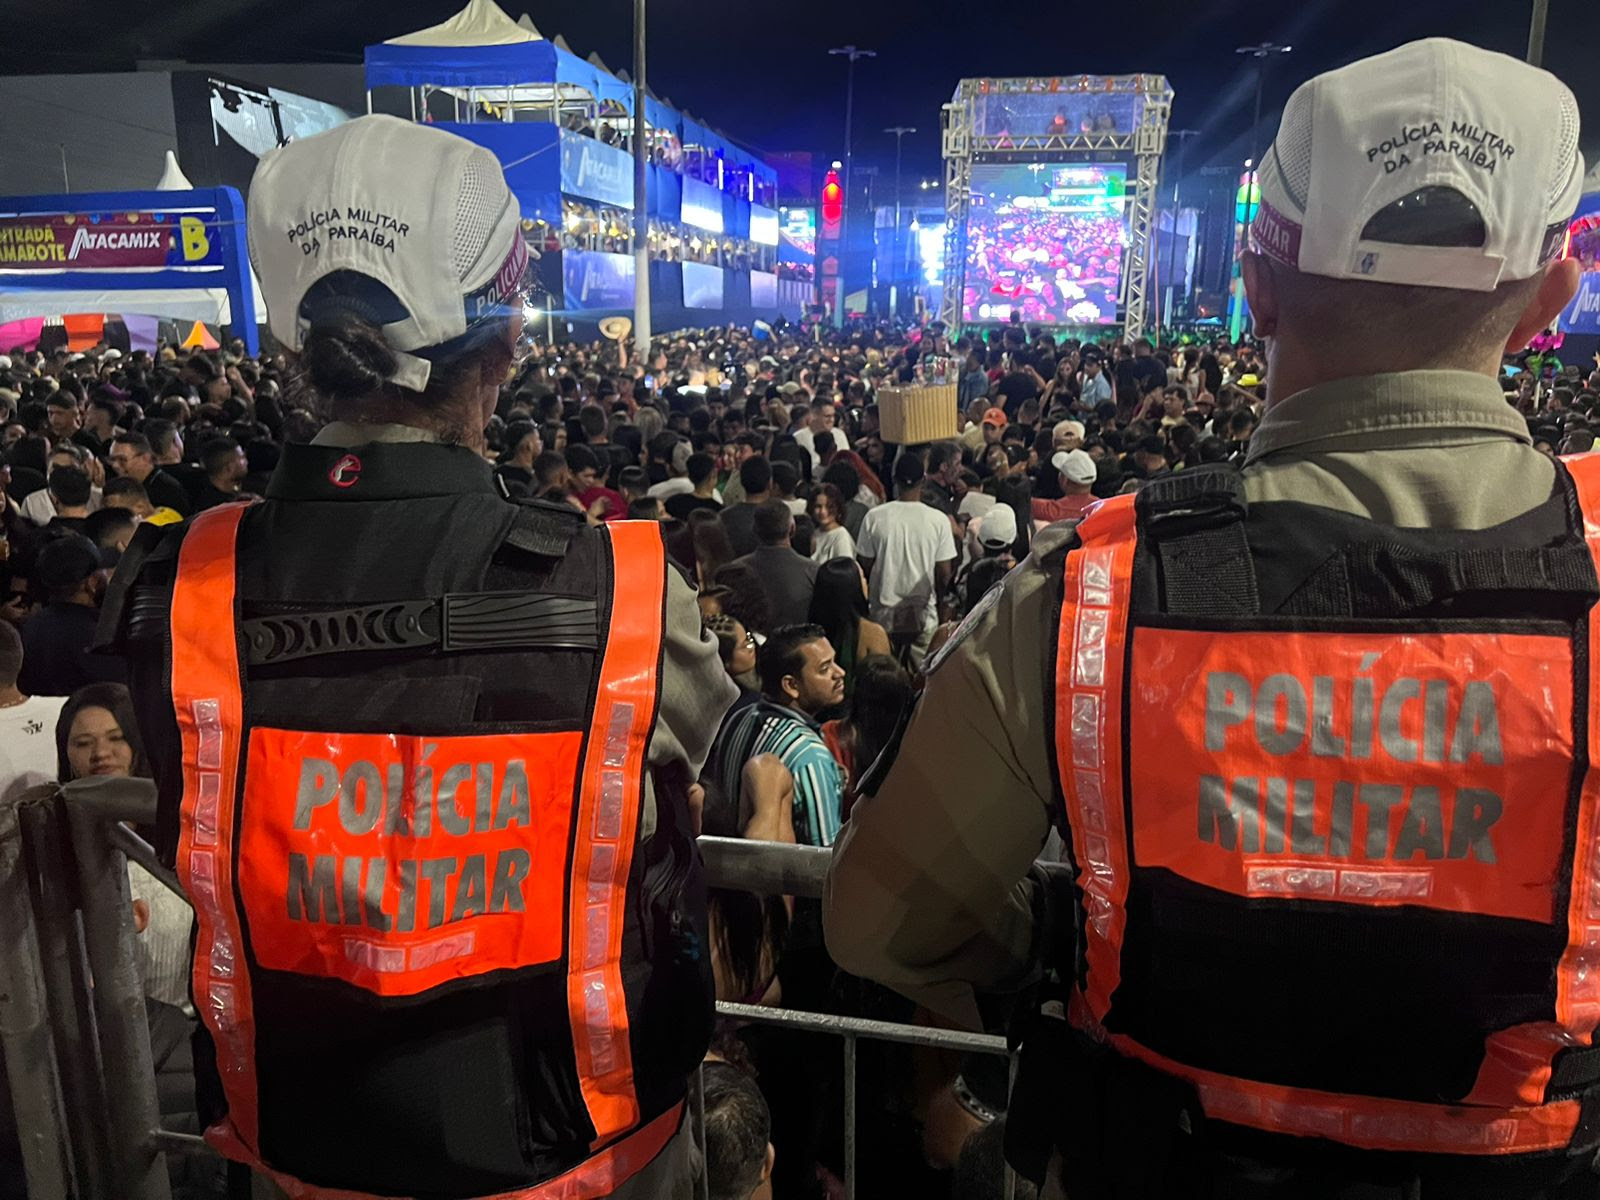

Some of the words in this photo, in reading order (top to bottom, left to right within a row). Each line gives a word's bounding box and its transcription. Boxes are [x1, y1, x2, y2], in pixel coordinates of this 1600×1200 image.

[1366, 122, 1442, 162] POLÍCIA
[1451, 121, 1515, 160] MILITAR
[1384, 154, 1411, 174] DA
[1423, 140, 1496, 175] PARAÍBA
[68, 227, 161, 260] ATACAMIX
[180, 216, 210, 261] B
[287, 208, 341, 243] POLÍCIA
[347, 207, 410, 237] MILITAR
[301, 237, 321, 258] DA
[328, 226, 395, 253] PARAÍBA
[1204, 652, 1504, 765] POLÍCIA
[293, 743, 530, 838] POLÍCIA
[1198, 774, 1503, 864] MILITAR
[286, 848, 531, 933] MILITAR
